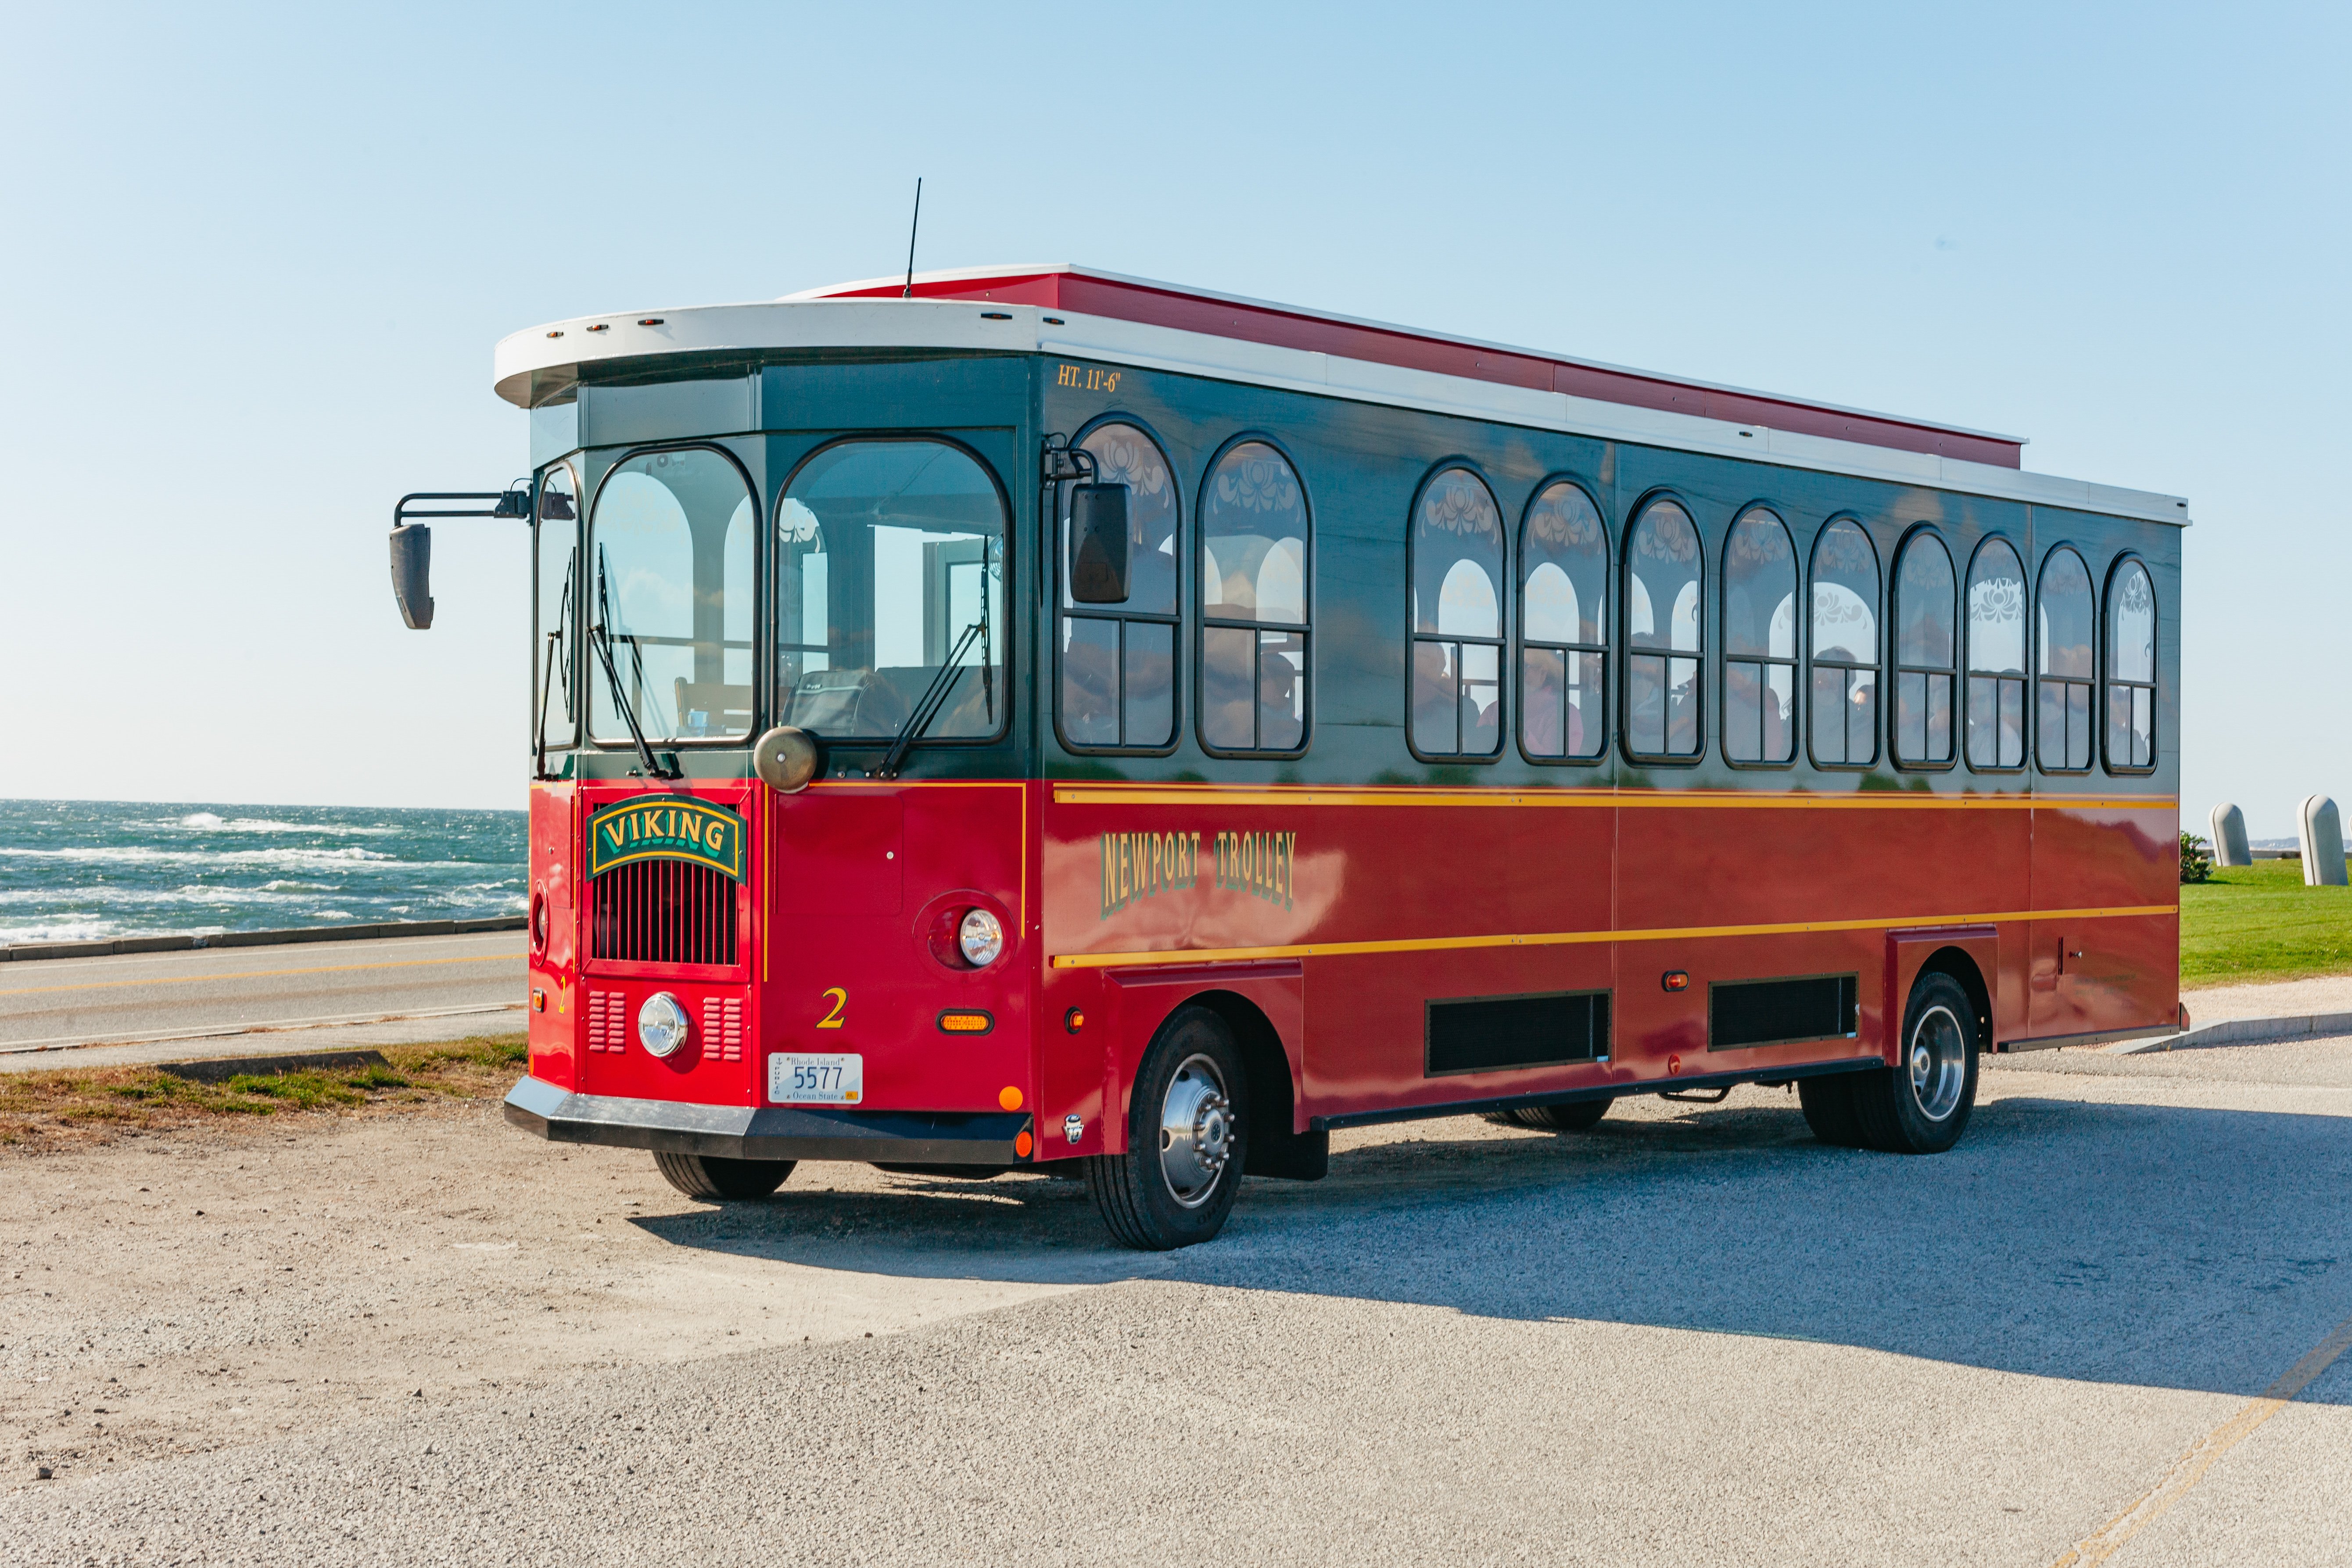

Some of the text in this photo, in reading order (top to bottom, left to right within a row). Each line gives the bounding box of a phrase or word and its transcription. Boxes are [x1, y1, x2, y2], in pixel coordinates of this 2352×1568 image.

[1058, 364, 1081, 388] HT.
[602, 809, 725, 858] VIKING
[1101, 831, 1296, 920] NEWPORT TROLLEY
[559, 975, 566, 1014] 2
[815, 986, 848, 1029] 2
[791, 1057, 814, 1066] Rhode
[794, 1066, 843, 1089] 5577
